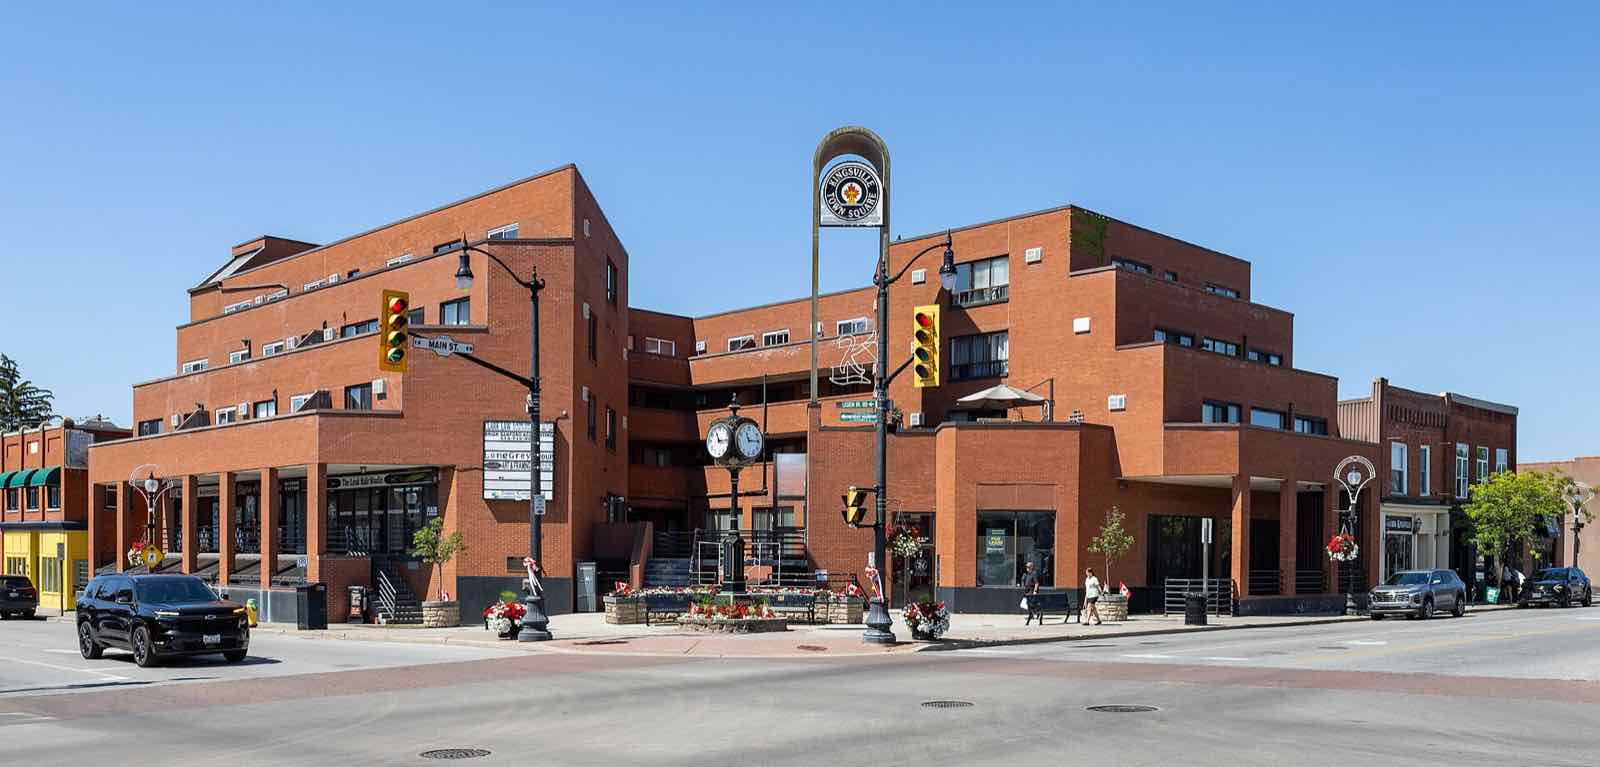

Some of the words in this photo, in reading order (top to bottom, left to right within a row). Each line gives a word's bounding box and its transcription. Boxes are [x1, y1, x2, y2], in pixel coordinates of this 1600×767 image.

[829, 167, 875, 188] KINGSVILLE
[827, 192, 846, 216] TOWN
[848, 193, 877, 218] SQUARE
[429, 340, 448, 351] MAIN
